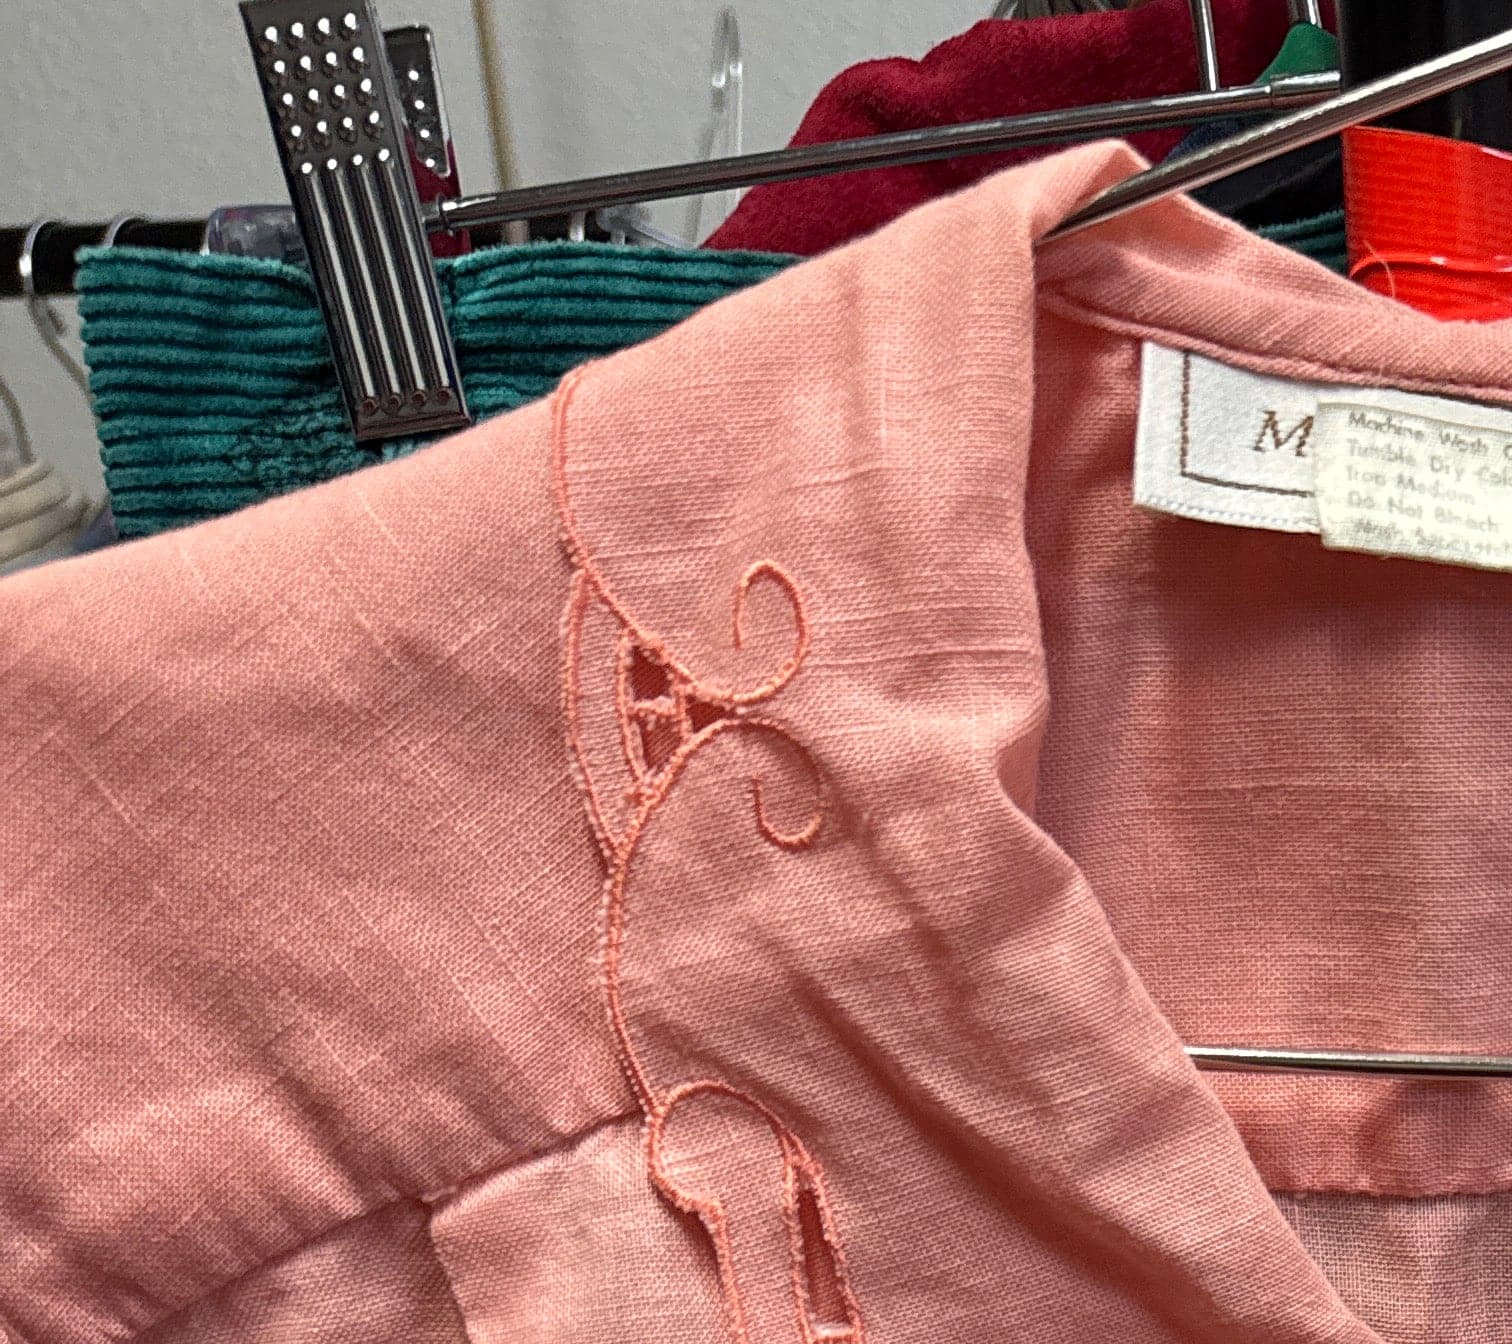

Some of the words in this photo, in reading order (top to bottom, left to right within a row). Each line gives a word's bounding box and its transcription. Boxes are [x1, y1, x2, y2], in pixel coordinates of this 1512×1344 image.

[1348, 411, 1424, 442] Machine
[1439, 431, 1488, 456] Wash
[1429, 454, 1465, 482] Dry
[1388, 497, 1423, 519] Not
